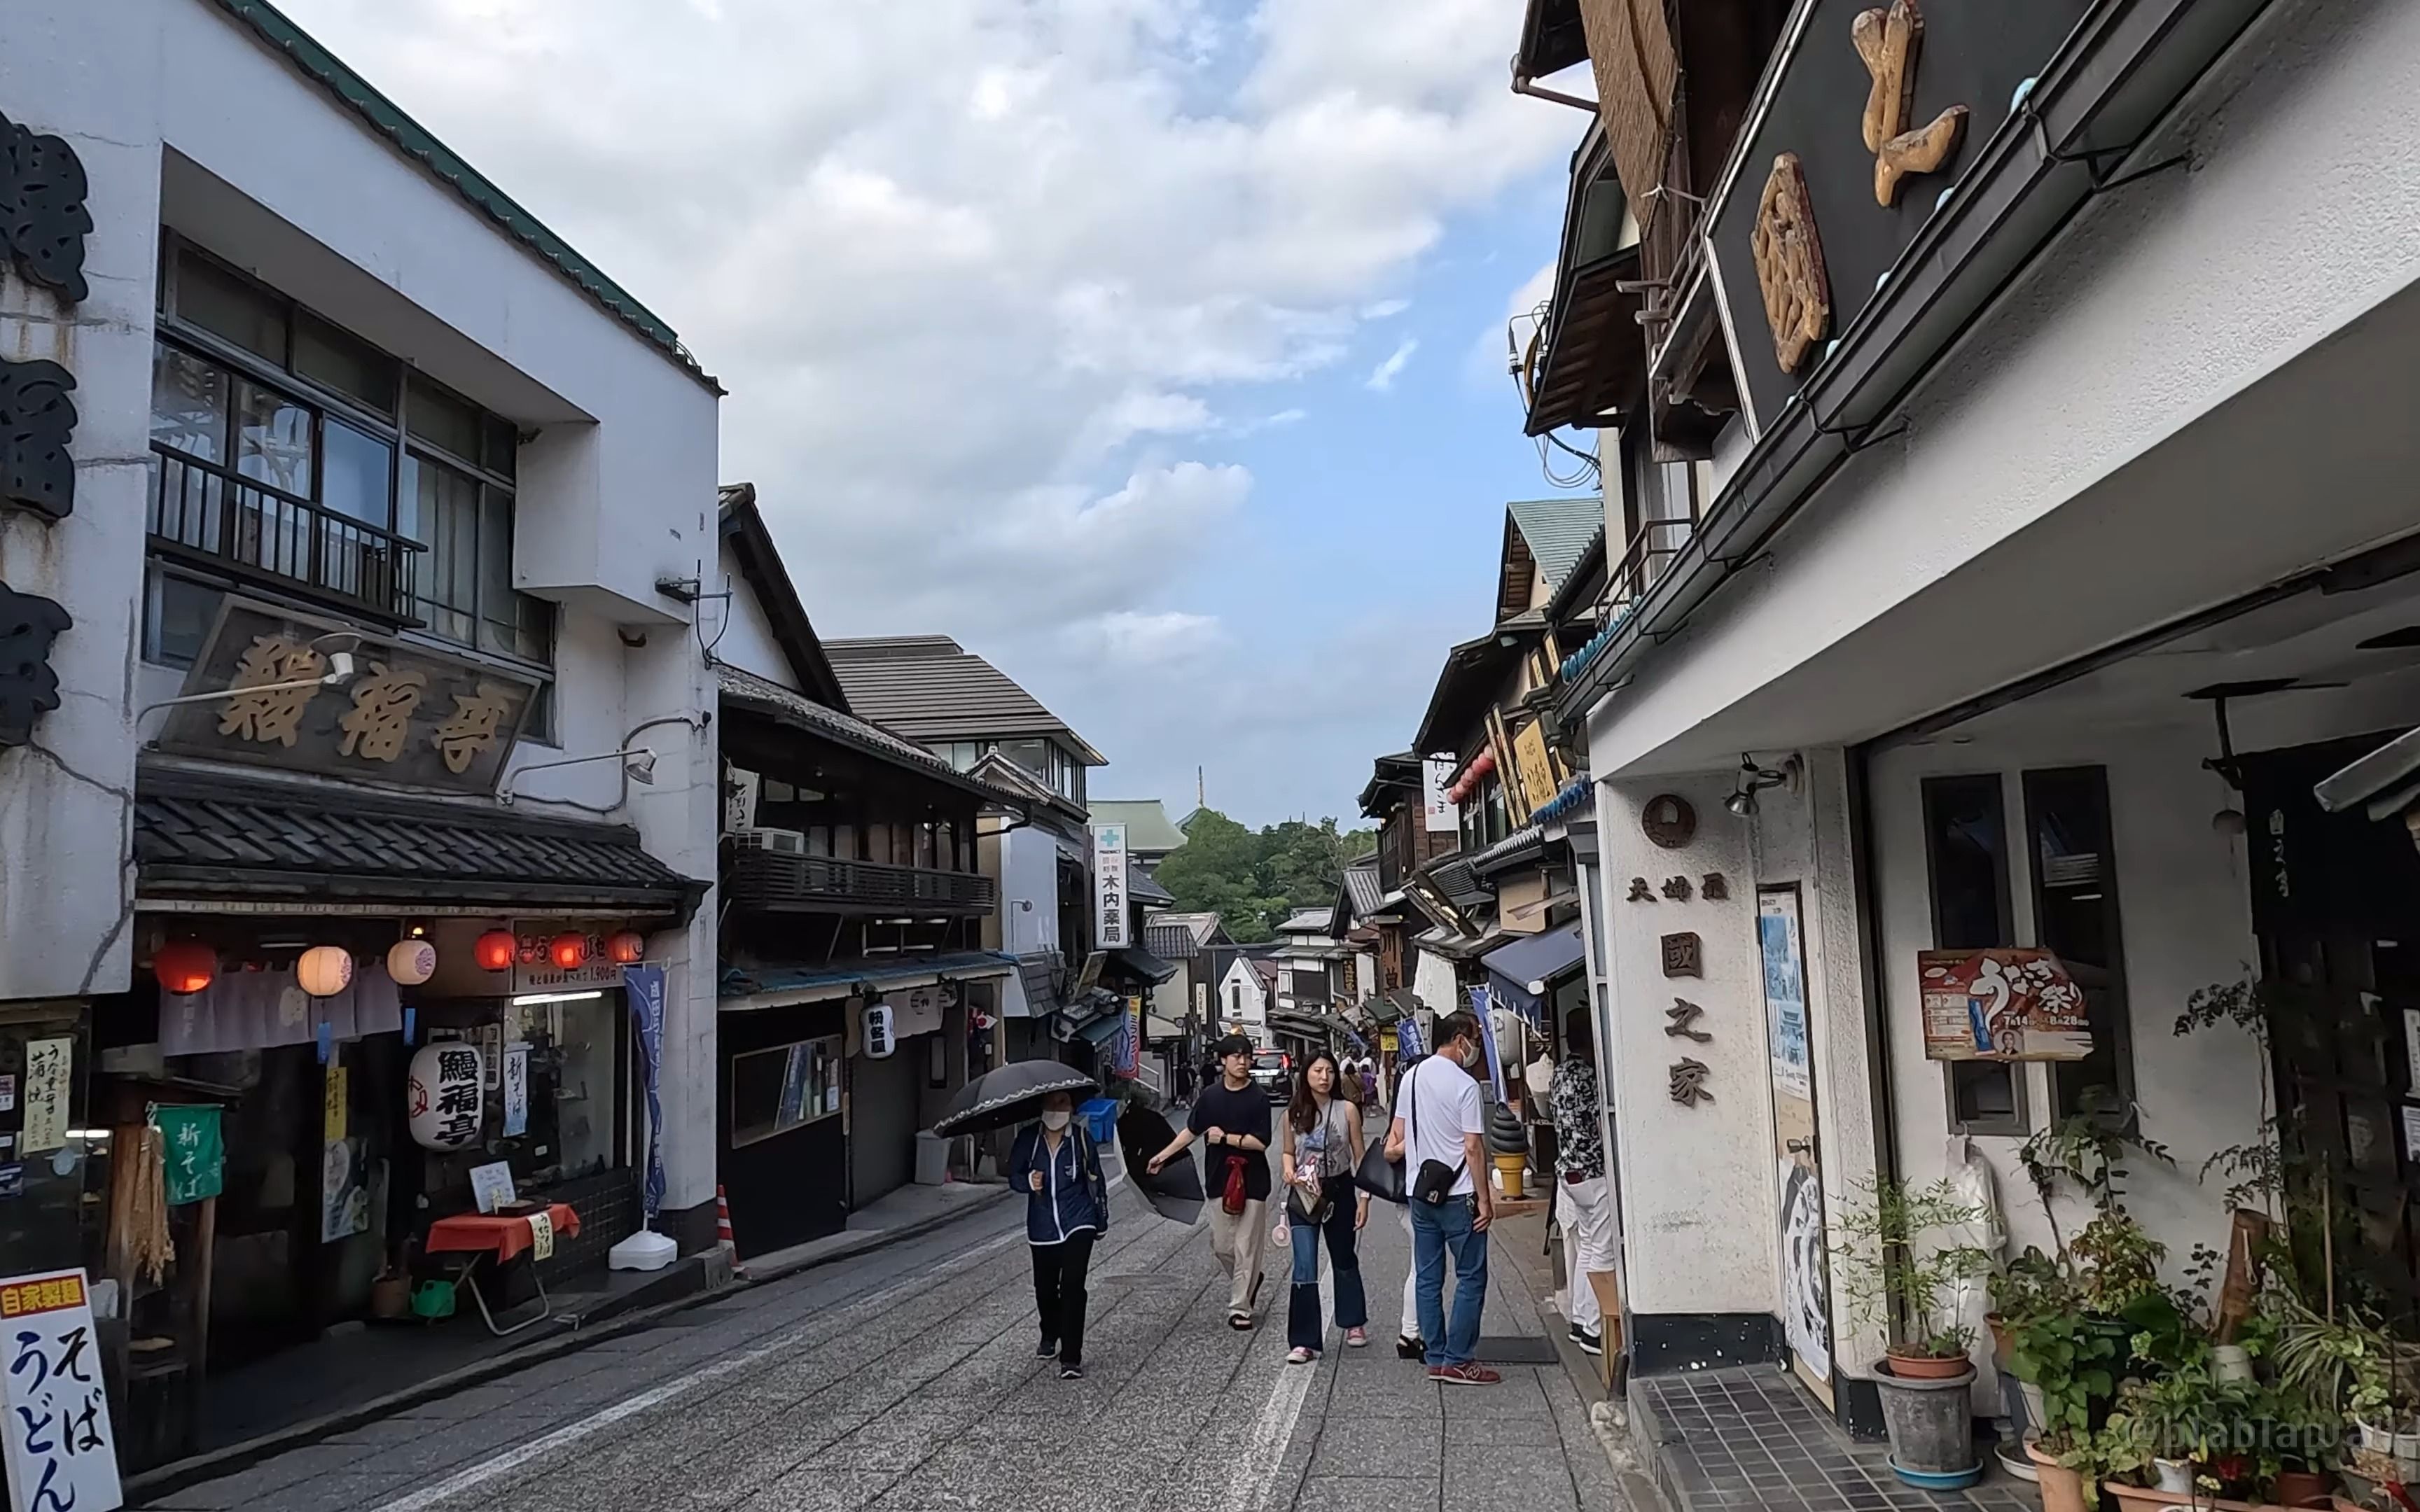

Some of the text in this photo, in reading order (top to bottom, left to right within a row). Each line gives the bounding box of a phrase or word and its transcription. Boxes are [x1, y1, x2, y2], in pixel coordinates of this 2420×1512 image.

[1102, 875, 1120, 943] 木内薬局
[1661, 931, 1715, 1107] 國之家
[435, 1050, 479, 1145] 鰻福亭
[176, 1123, 202, 1200] 新そば
[9, 1331, 76, 1512] うどん
[53, 1326, 104, 1456] そば
